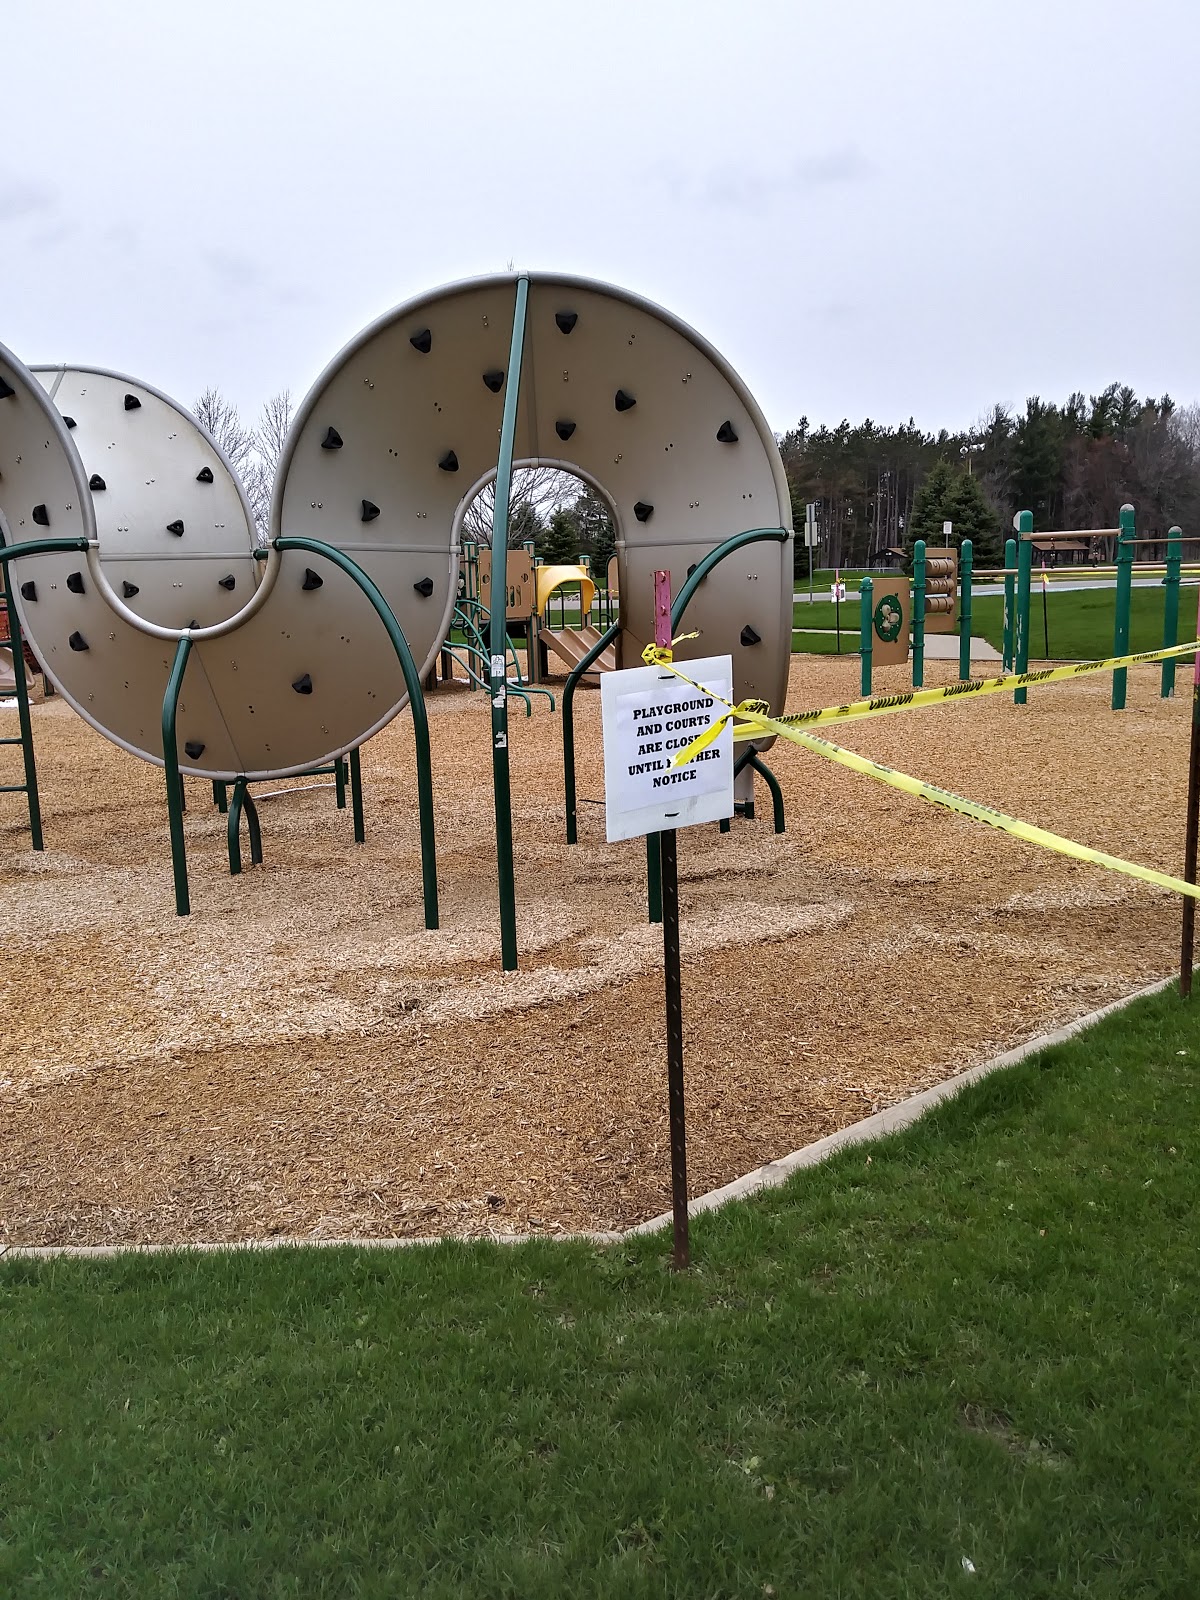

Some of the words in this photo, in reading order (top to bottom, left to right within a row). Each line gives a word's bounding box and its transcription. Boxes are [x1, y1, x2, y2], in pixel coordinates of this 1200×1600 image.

[633, 698, 714, 720] PLAYGROUND
[636, 723, 662, 737] AND
[665, 714, 711, 731] COURTS
[638, 742, 663, 755] ARE
[628, 760, 664, 776] UNTIL
[653, 769, 697, 788] NOTICE
